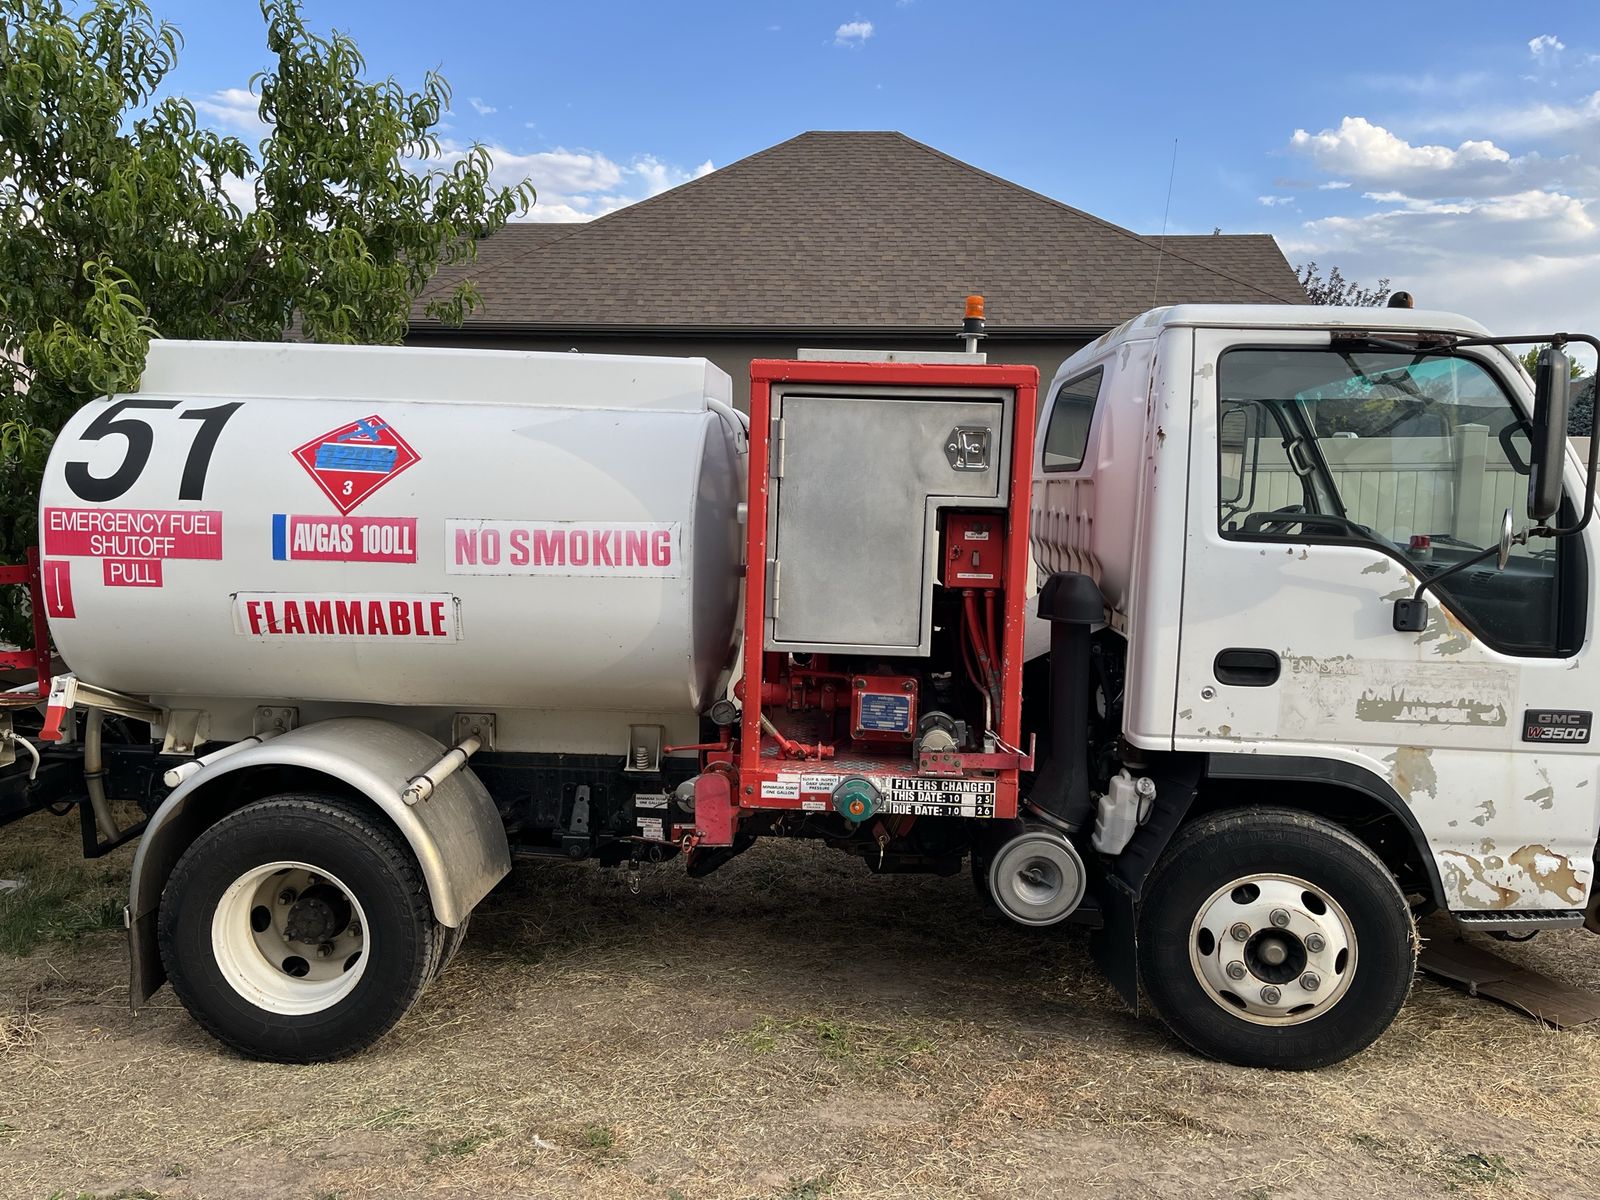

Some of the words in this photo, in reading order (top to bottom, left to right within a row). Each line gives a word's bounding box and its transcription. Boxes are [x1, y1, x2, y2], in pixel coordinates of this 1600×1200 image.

[64, 398, 246, 503] 51
[342, 480, 353, 495] 3
[50, 511, 166, 534] EMERGENCY
[170, 514, 216, 536] FUEL
[90, 534, 175, 556] SHUTOFF
[293, 521, 353, 553] AVGAS
[361, 524, 413, 555] 100LL
[455, 528, 501, 566] NO
[509, 529, 671, 567] SMOKING
[110, 563, 156, 584] PULL
[246, 600, 448, 637] FLAMMABLE
[1538, 714, 1581, 724] GMC
[1527, 726, 1588, 740] W3500
[893, 790, 915, 802] THIS
[917, 791, 946, 803] DATE:
[895, 779, 938, 791] FILTERS
[941, 780, 992, 793] CHANGED
[892, 804, 912, 815] DUE
[914, 804, 943, 816] DATE:
